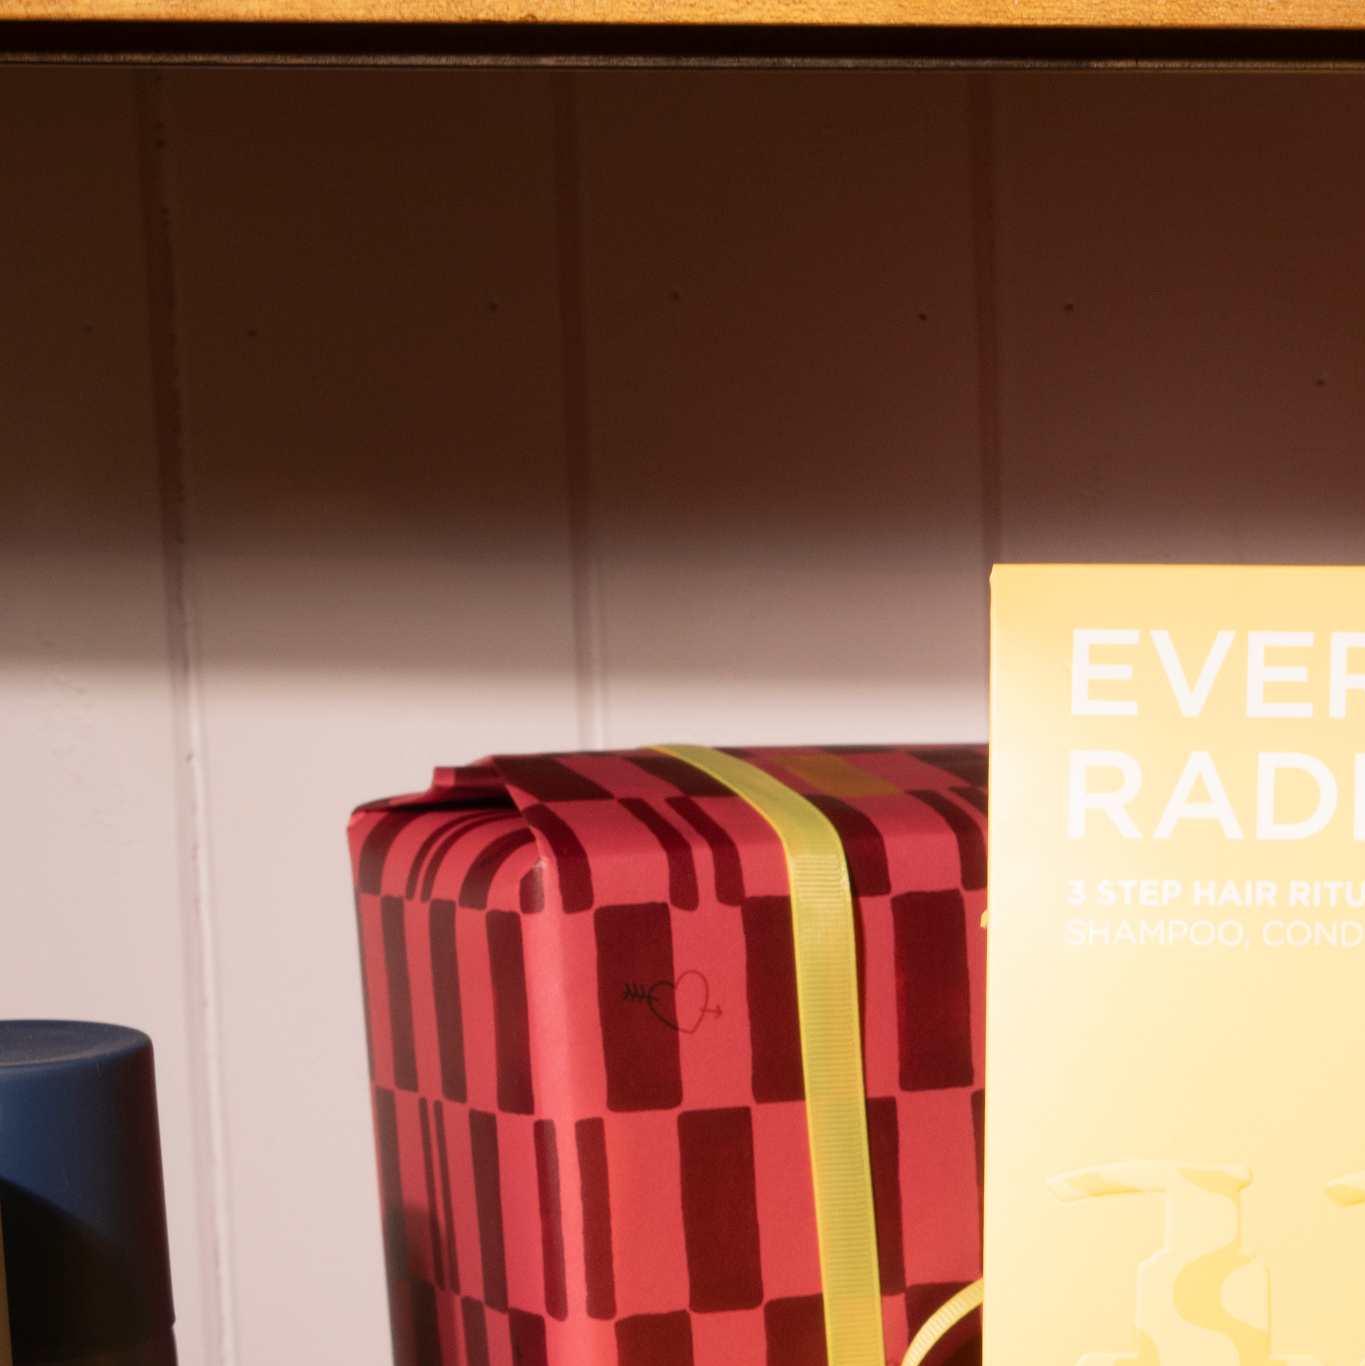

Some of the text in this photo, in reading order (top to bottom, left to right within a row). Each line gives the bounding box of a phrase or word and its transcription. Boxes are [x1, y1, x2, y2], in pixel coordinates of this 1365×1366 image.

[1067, 879, 1086, 905] 3
[1096, 879, 1182, 905] STEP
[1193, 880, 1277, 906] HAIR
[1066, 919, 1250, 950] SHAMPOO,
